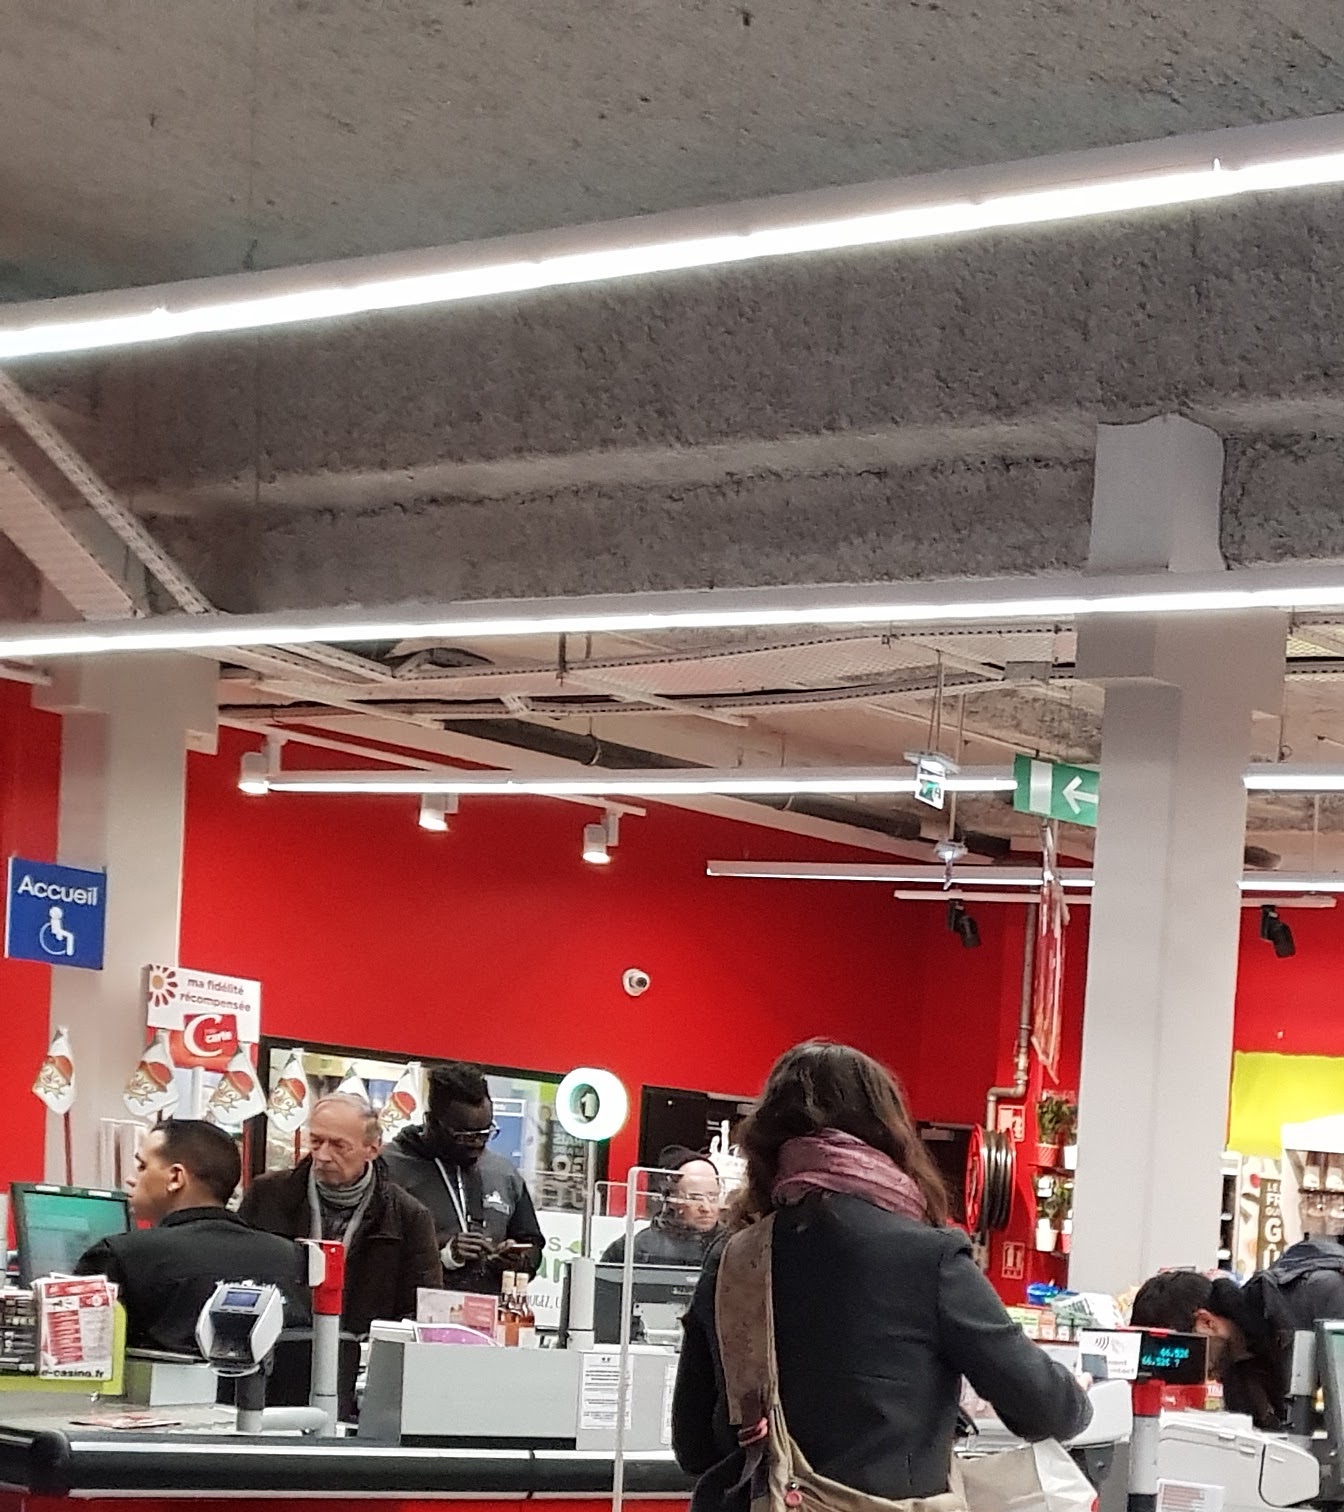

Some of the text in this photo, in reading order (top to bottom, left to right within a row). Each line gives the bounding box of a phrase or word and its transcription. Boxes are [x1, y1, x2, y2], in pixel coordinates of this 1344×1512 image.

[17, 874, 98, 906] Accueil
[180, 992, 251, 1012] récompensée
[580, 1092, 597, 1118] 1
